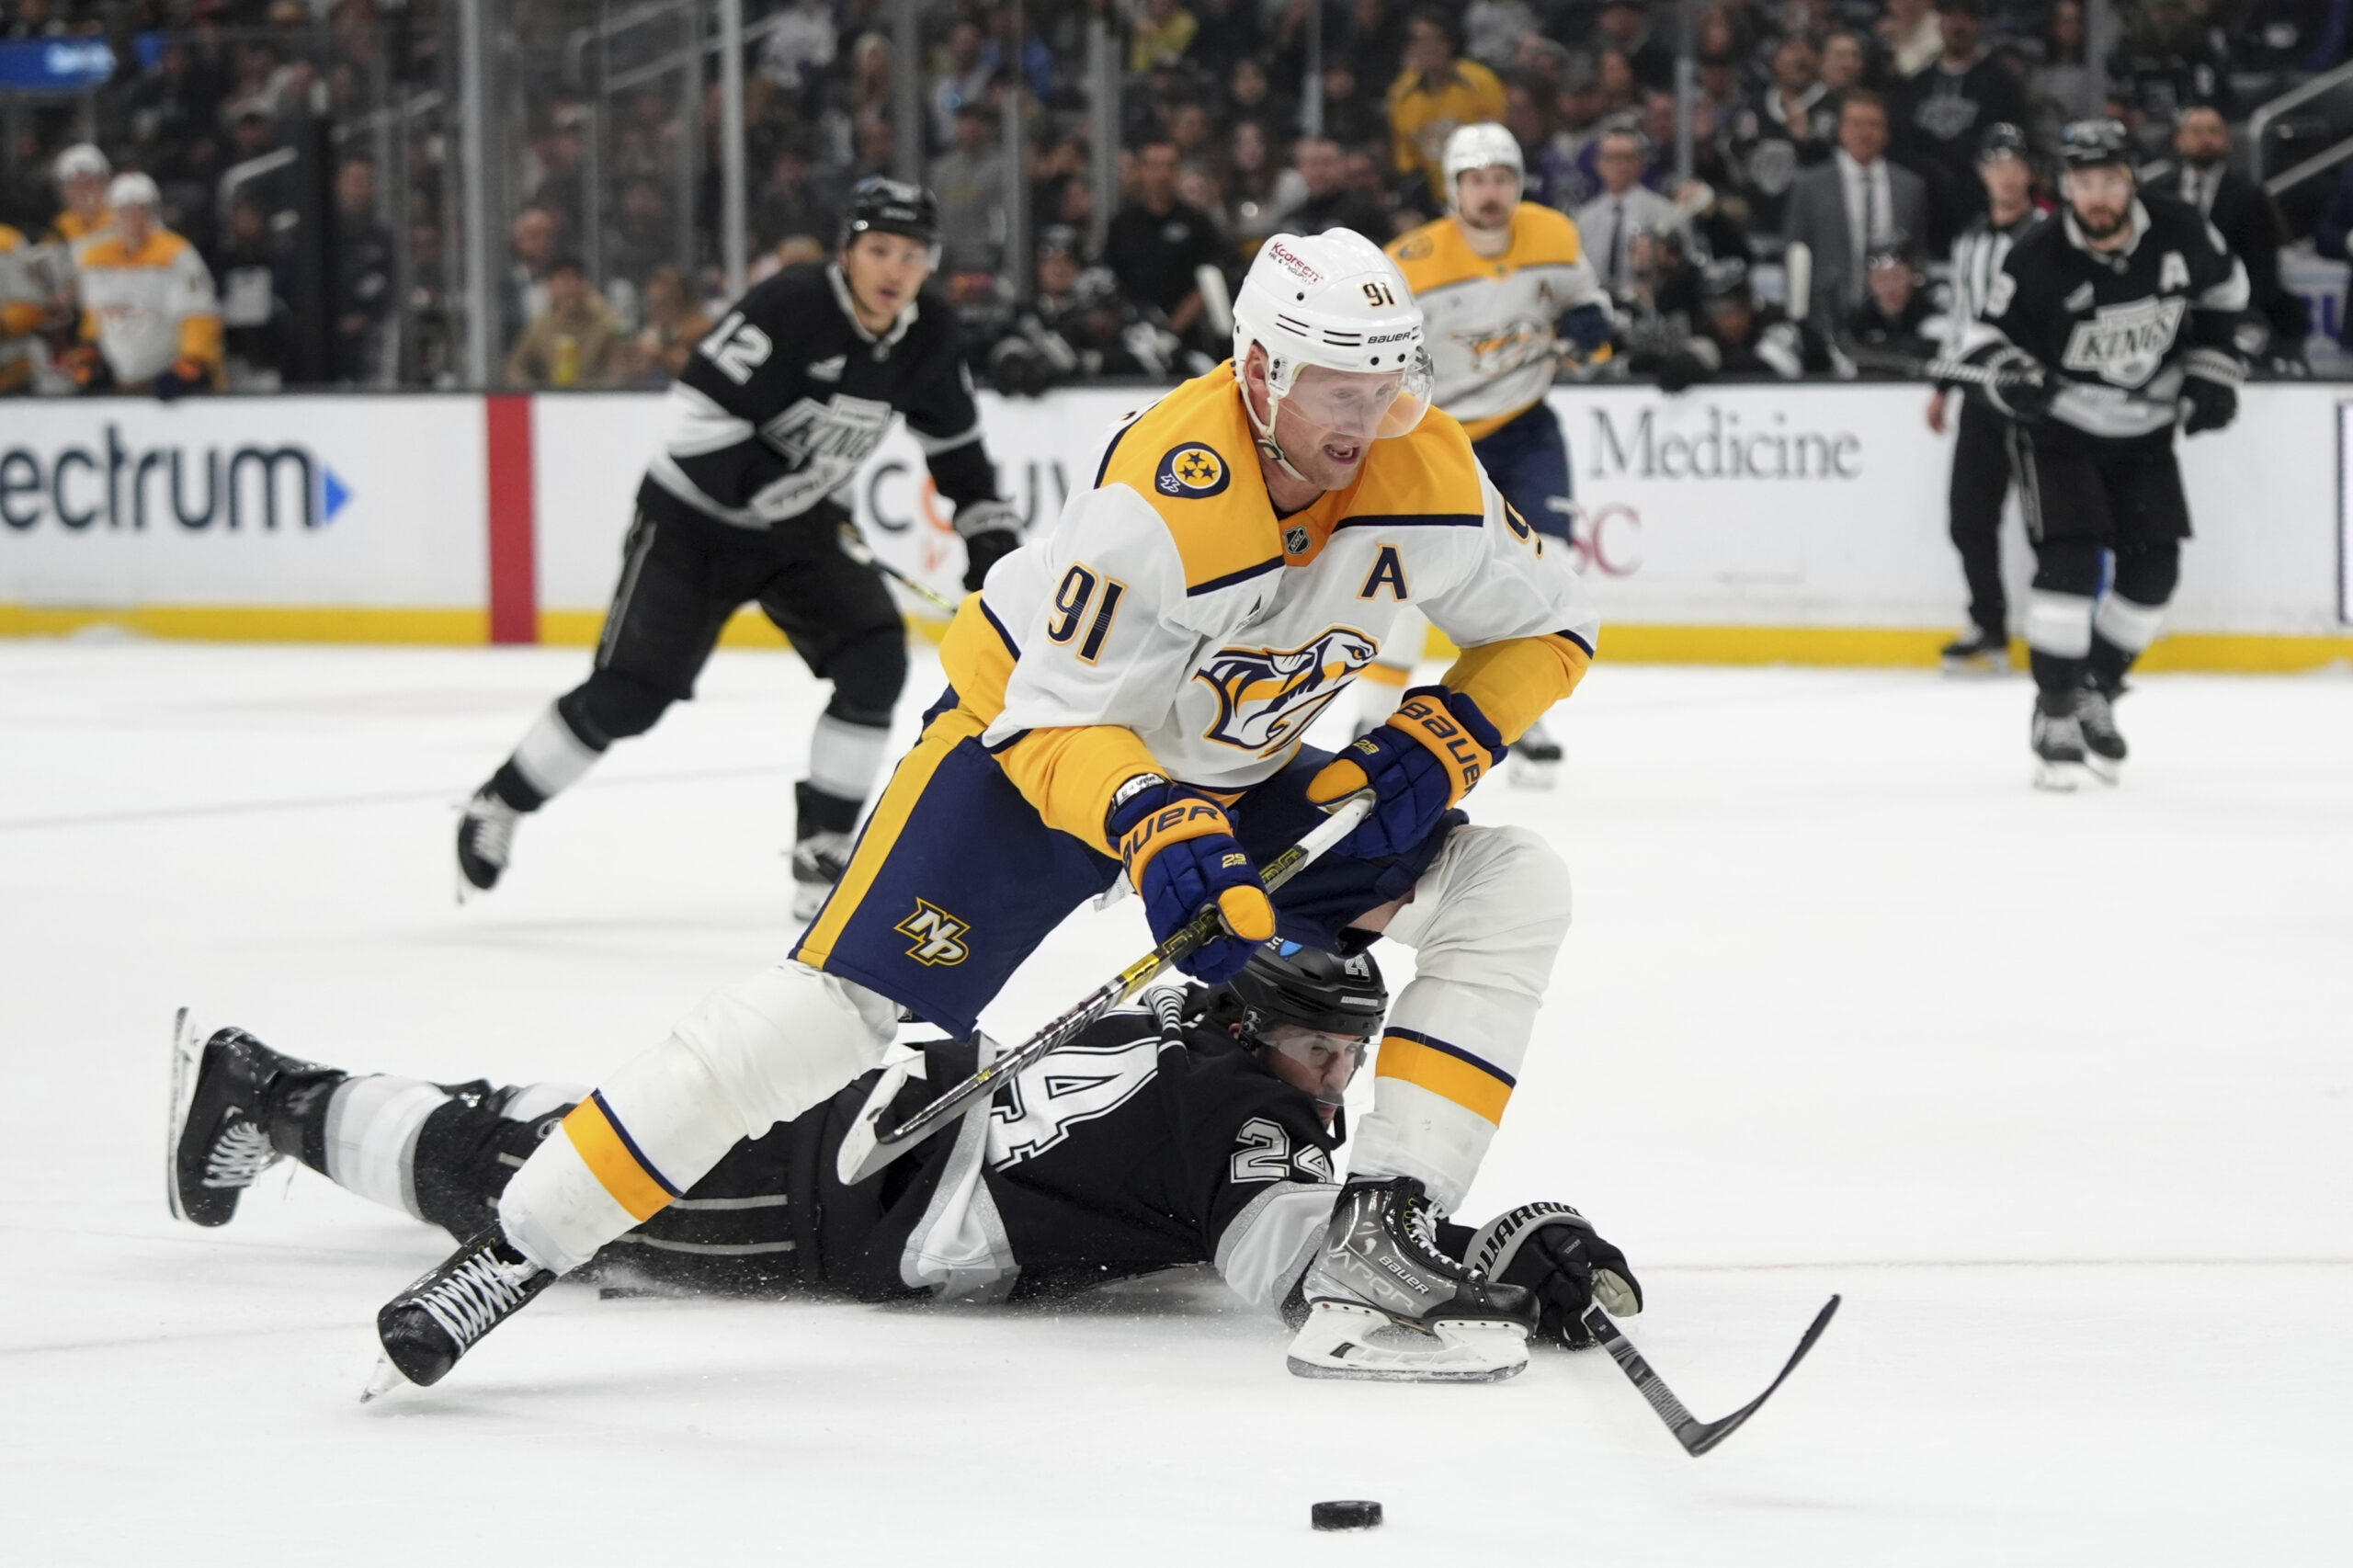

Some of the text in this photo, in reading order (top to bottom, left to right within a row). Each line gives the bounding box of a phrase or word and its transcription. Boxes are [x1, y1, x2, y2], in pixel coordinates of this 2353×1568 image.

[1362, 281, 1395, 306] 91
[699, 311, 773, 385] 12
[1588, 405, 1864, 481] Medicine
[1290, 528, 1304, 550] NHL
[1356, 542, 1411, 603] A
[1046, 561, 1129, 667] 91
[1222, 853, 1246, 869] 29
[1230, 1116, 1336, 1184] 24
[1473, 1201, 1581, 1280] WARRIO
[1378, 1256, 1430, 1295] BAUER
